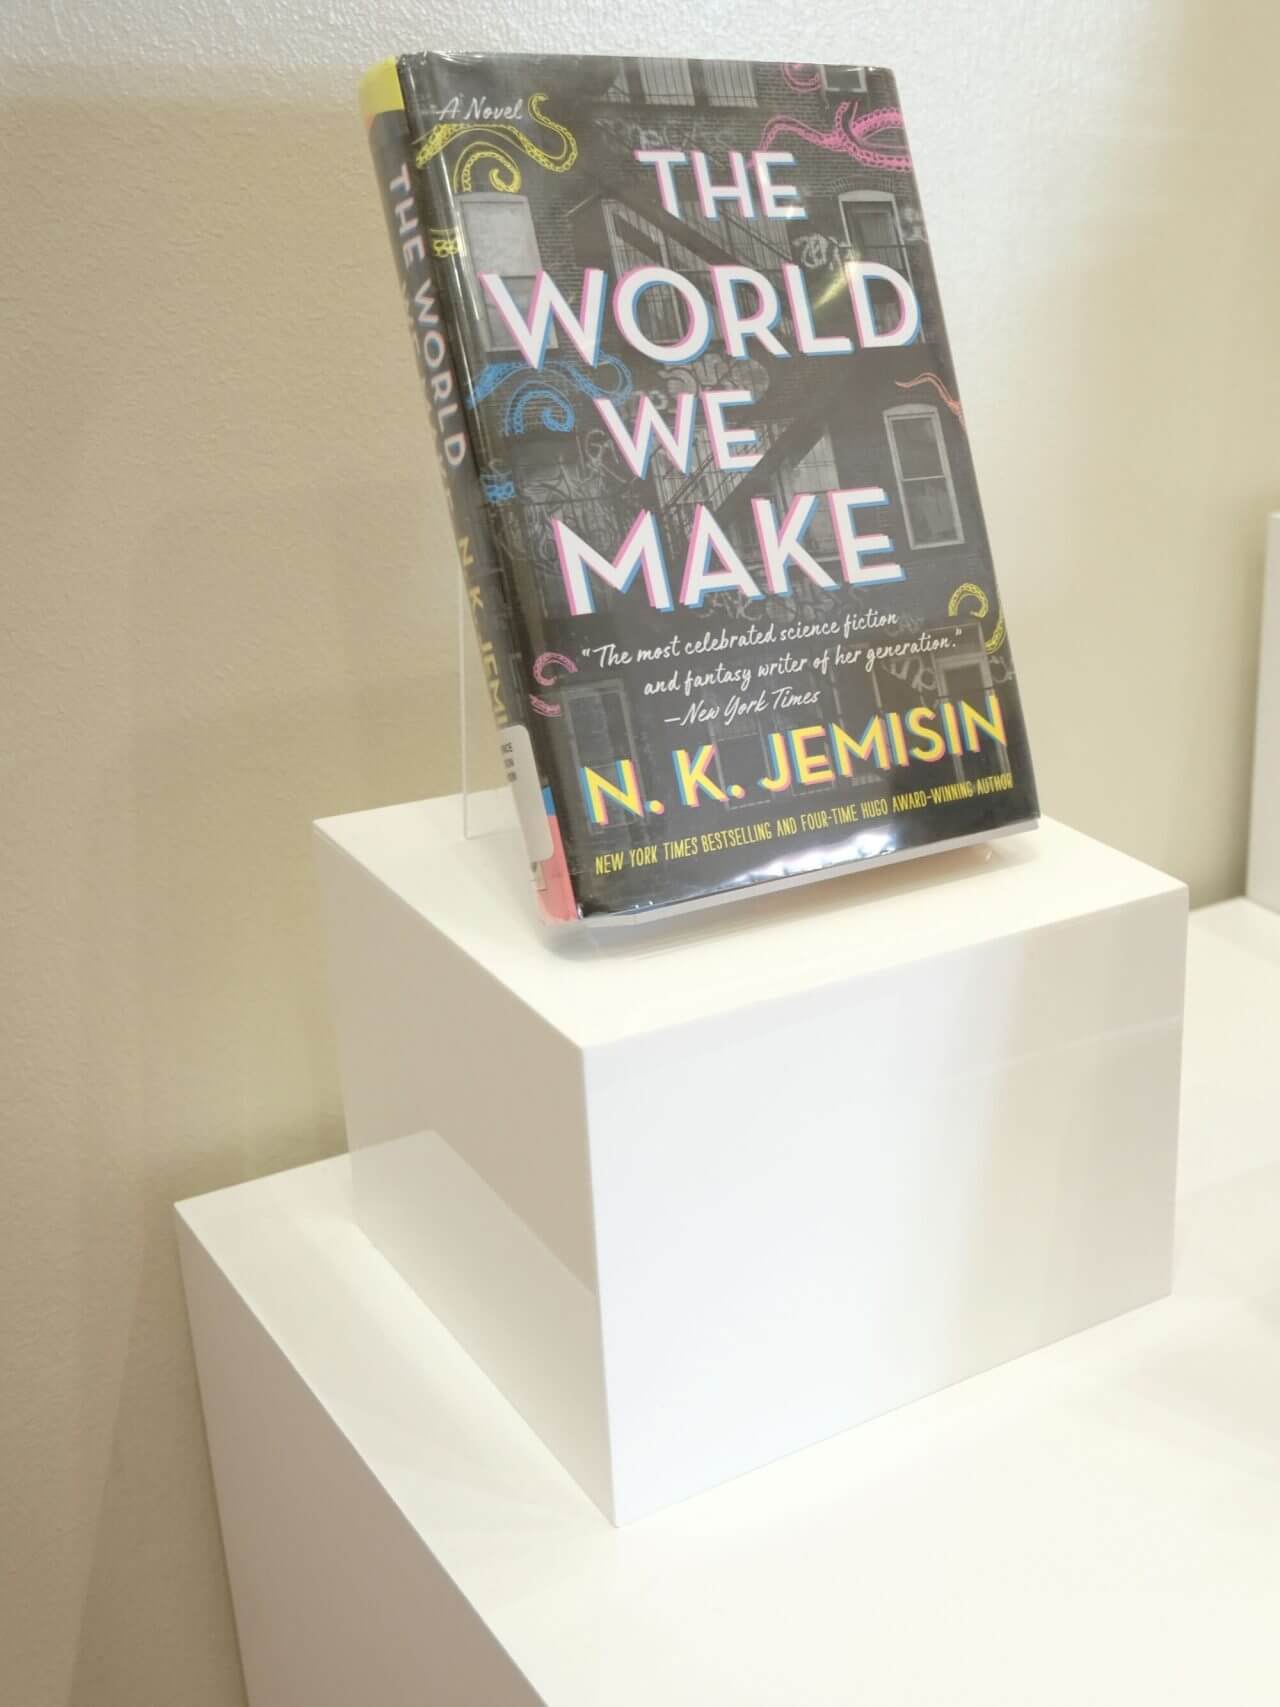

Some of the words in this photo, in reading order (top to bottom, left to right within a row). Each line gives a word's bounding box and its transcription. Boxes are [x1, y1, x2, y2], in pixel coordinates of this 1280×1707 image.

[436, 96, 461, 122] A
[463, 96, 523, 121] Novel
[633, 149, 809, 222] THE
[388, 163, 427, 273] THE
[413, 278, 468, 469] WORLD
[480, 261, 922, 370] WORLD
[593, 389, 767, 481] WE
[552, 487, 905, 616] MAKE
[636, 635, 681, 663] most
[684, 622, 777, 656] celebrated
[780, 620, 841, 642] science
[843, 608, 899, 639] fiction
[644, 670, 681, 696] and
[684, 662, 753, 697] fantasy
[757, 652, 808, 678] writer
[812, 651, 829, 675] of
[835, 642, 862, 665] her
[723, 689, 769, 726] York
[772, 685, 821, 710] Times
[579, 758, 665, 826] N.
[671, 744, 746, 808] K.
[758, 694, 1008, 793] JEMISIN
[594, 851, 626, 876] NEW
[628, 844, 659, 869] YORK
[662, 836, 698, 861] TIMES
[700, 821, 773, 854] BESTSELLING
[776, 815, 799, 838] AND
[800, 804, 859, 833] FOUR-TIME
[861, 798, 889, 820] HUGO
[891, 782, 975, 813] AWARD-WINNING
[975, 772, 1014, 797] AUTHOR
